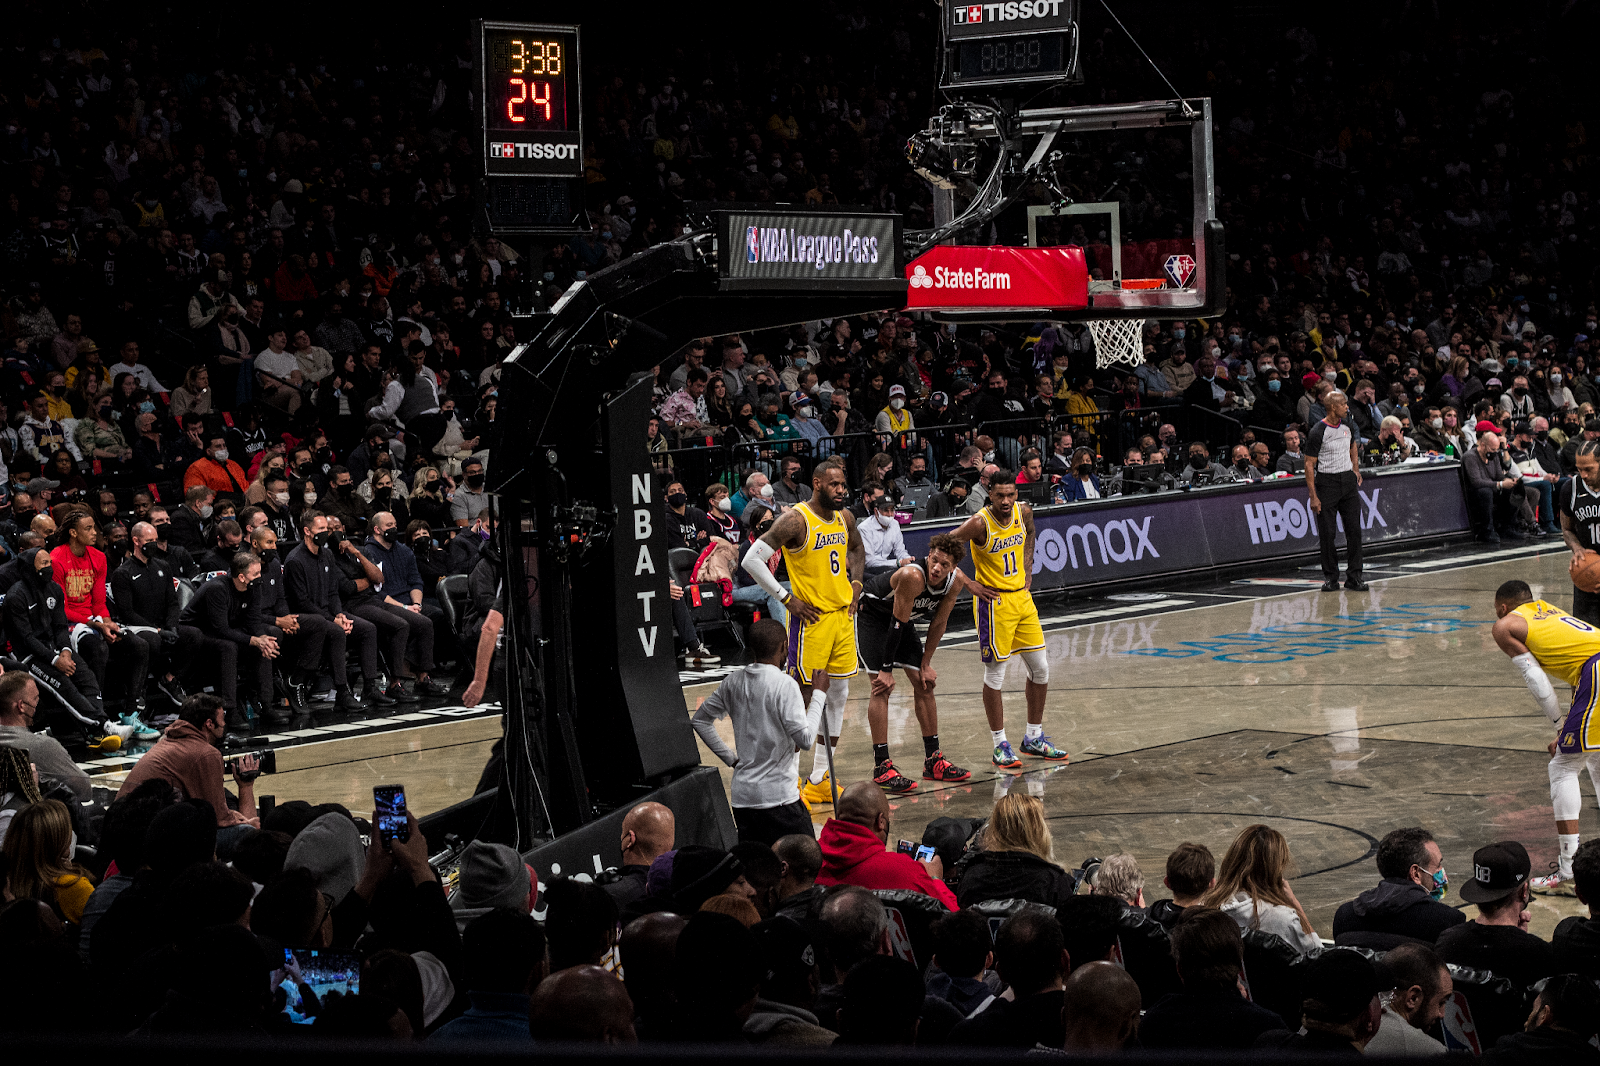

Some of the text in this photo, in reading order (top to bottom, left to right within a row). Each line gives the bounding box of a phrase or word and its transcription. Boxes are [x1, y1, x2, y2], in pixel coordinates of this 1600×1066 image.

[983, 0, 1064, 22] TISSOT
[511, 40, 561, 75] 3:38
[507, 78, 551, 122] 24
[515, 143, 579, 160] TISSOT
[760, 227, 879, 270] NBA League Pass
[1574, 504, 1600, 522] BROO
[811, 532, 846, 551] LAKERS
[987, 532, 1024, 554] LAKERS
[631, 473, 659, 658] NBA TV
[829, 549, 841, 577] 6
[1002, 550, 1018, 577] 11
